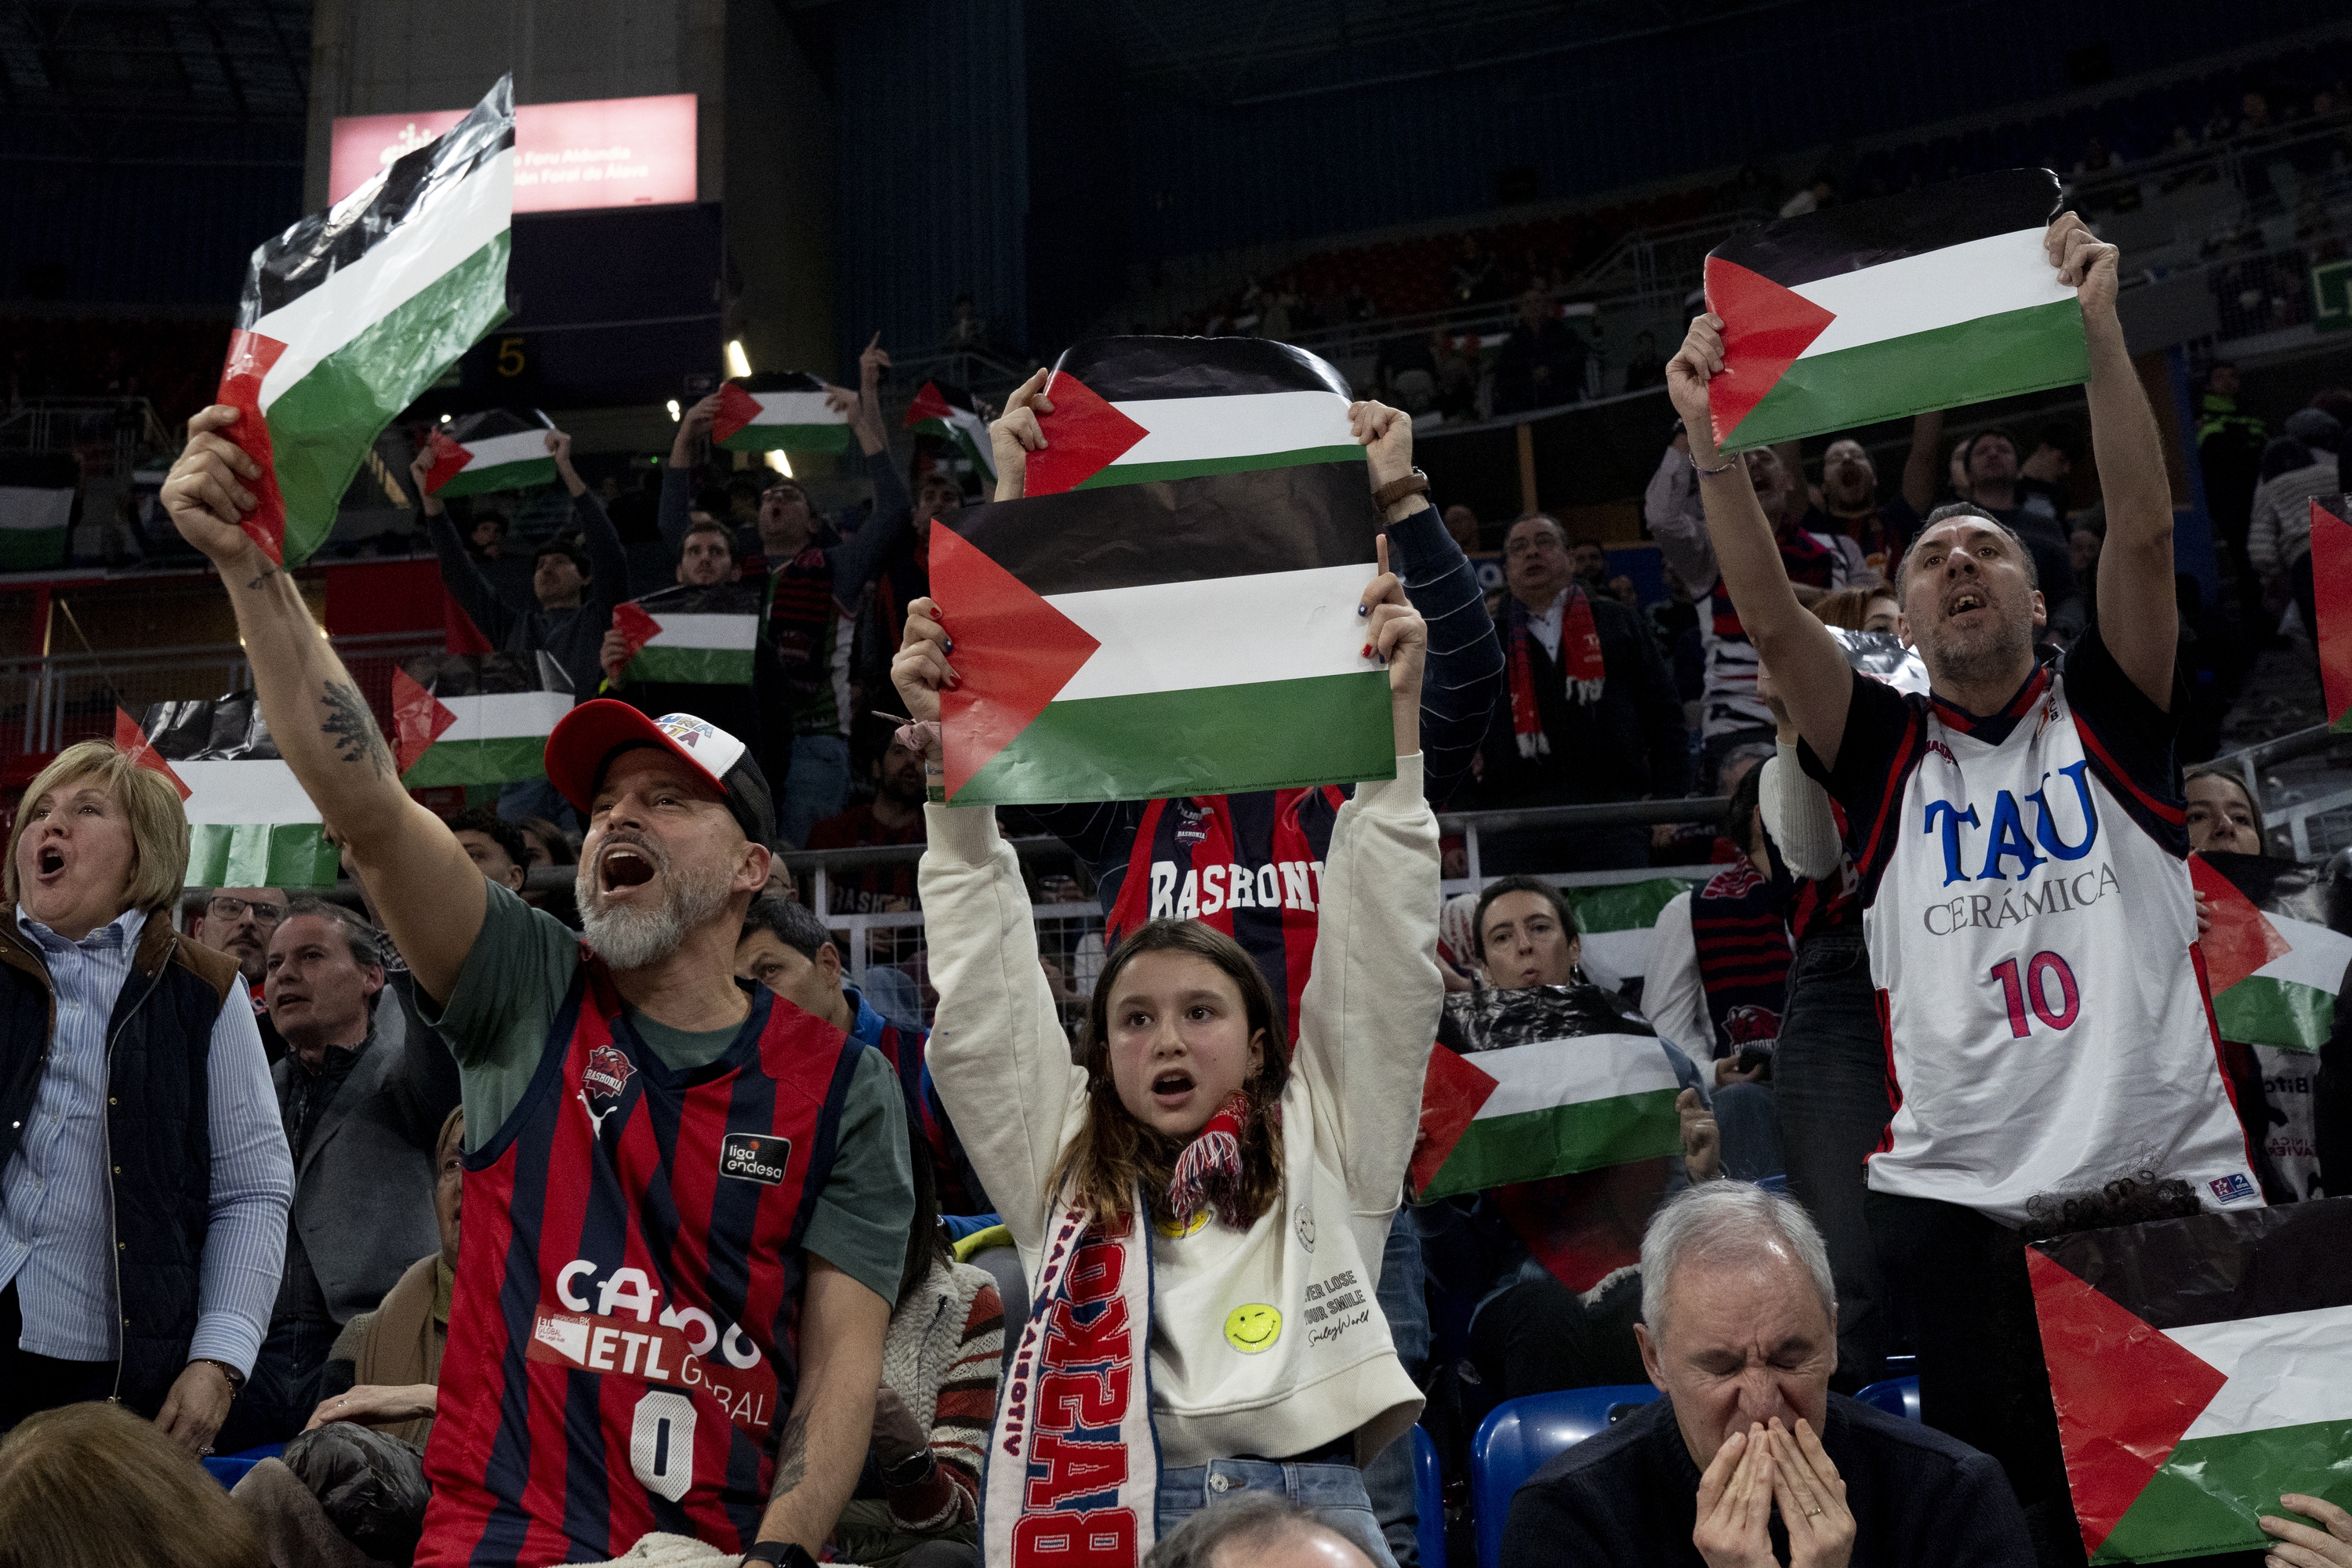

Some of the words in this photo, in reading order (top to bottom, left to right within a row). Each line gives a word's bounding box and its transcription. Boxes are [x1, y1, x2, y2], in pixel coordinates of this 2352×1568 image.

[498, 338, 524, 376] 5
[1214, 783, 1239, 792] segundo
[1177, 830, 1206, 840] BASKONIA
[1924, 760, 2098, 887] TAU
[1924, 862, 2121, 935] CERÁMICA
[1991, 950, 2080, 1039] 10
[584, 1068, 623, 1091] BASKONIA
[728, 1160, 782, 1179] endesa
[729, 1145, 755, 1160] liga
[1324, 1270, 1357, 1293] LOSE
[1304, 1305, 1328, 1326] OUR
[1327, 1289, 1366, 1314] SMILE
[1308, 1309, 1369, 1348] SmileyWorld
[588, 1327, 670, 1380] ETL
[681, 1353, 769, 1426] GBAL
[630, 1391, 697, 1504] 0
[2216, 1541, 2241, 1550] bandera
